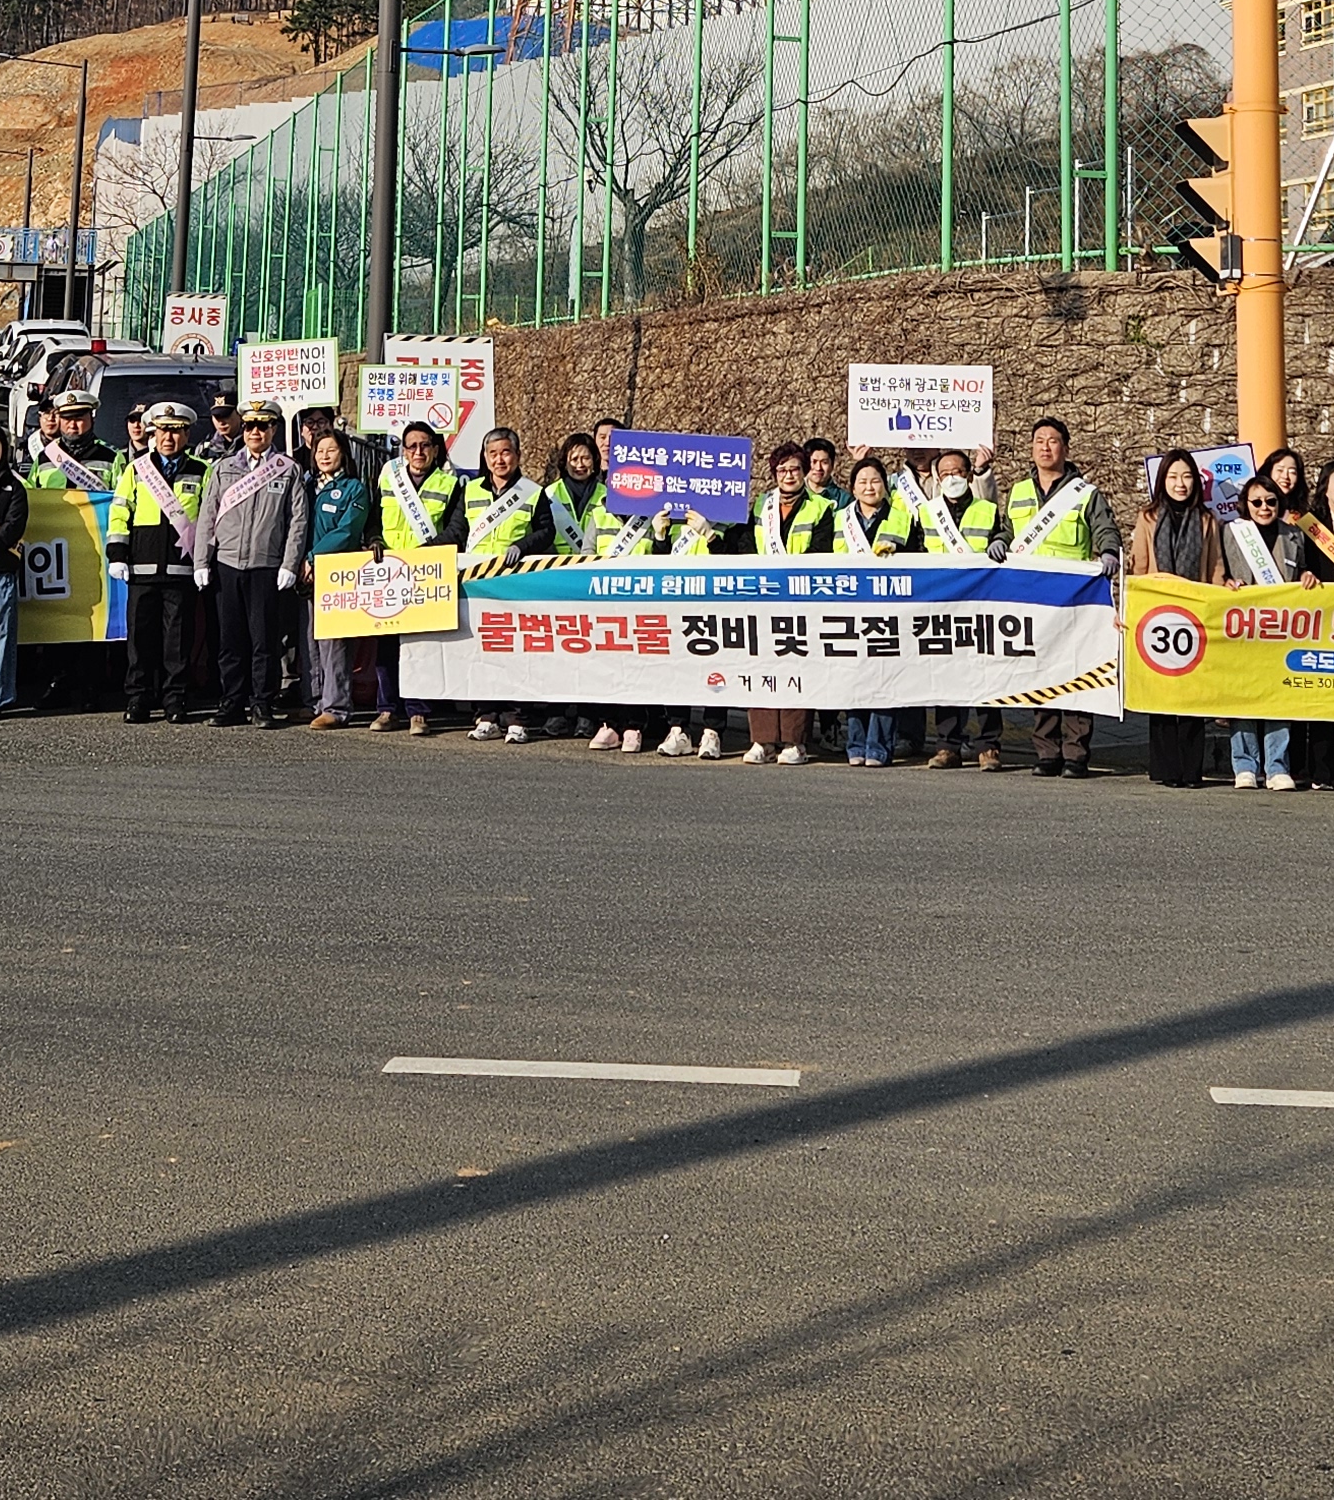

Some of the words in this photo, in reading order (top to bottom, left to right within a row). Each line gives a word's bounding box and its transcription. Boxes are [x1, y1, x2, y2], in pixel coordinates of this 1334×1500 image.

[171, 306, 220, 326] 공사중
[368, 372, 395, 385] 안전을
[399, 373, 417, 385] 위해
[420, 373, 438, 386] 보행
[441, 373, 450, 386] 및
[915, 378, 950, 393] 광고물
[953, 380, 984, 394] NO!
[368, 388, 395, 401] 주행중
[397, 388, 433, 401] 스마트폰
[859, 398, 901, 412] 안전하고
[904, 399, 936, 411] 깨끗한
[939, 400, 981, 412] 도시환경
[367, 404, 385, 416] 사용
[388, 404, 410, 416] 금지!
[914, 414, 953, 432] YES!
[613, 444, 668, 465] 청소년을
[673, 450, 714, 468] 지키는
[717, 453, 747, 470] 도시
[610, 473, 665, 492] 유해광고물
[666, 477, 687, 494] 없는
[689, 478, 721, 496] 깨끗한
[724, 481, 746, 497] 거리
[1306, 521, 1330, 546] 함께
[330, 567, 391, 586] 아이들의
[396, 563, 442, 582] 시선에
[588, 576, 655, 595] 시민과
[661, 575, 706, 595] 함께
[713, 576, 781, 595] 만드는
[787, 575, 859, 596] 깨끗한
[867, 575, 912, 597] 거제
[321, 588, 397, 612] 유해광고물은
[401, 585, 452, 605] 없습니다
[477, 612, 672, 654] 불법광고물
[682, 614, 759, 656] 정비
[771, 615, 809, 657] 및
[819, 615, 901, 657] 근절
[913, 614, 1036, 657] 캠페인
[1225, 608, 1322, 640] 어린이
[1151, 625, 1194, 656] 30
[1283, 676, 1314, 689] 속도는
